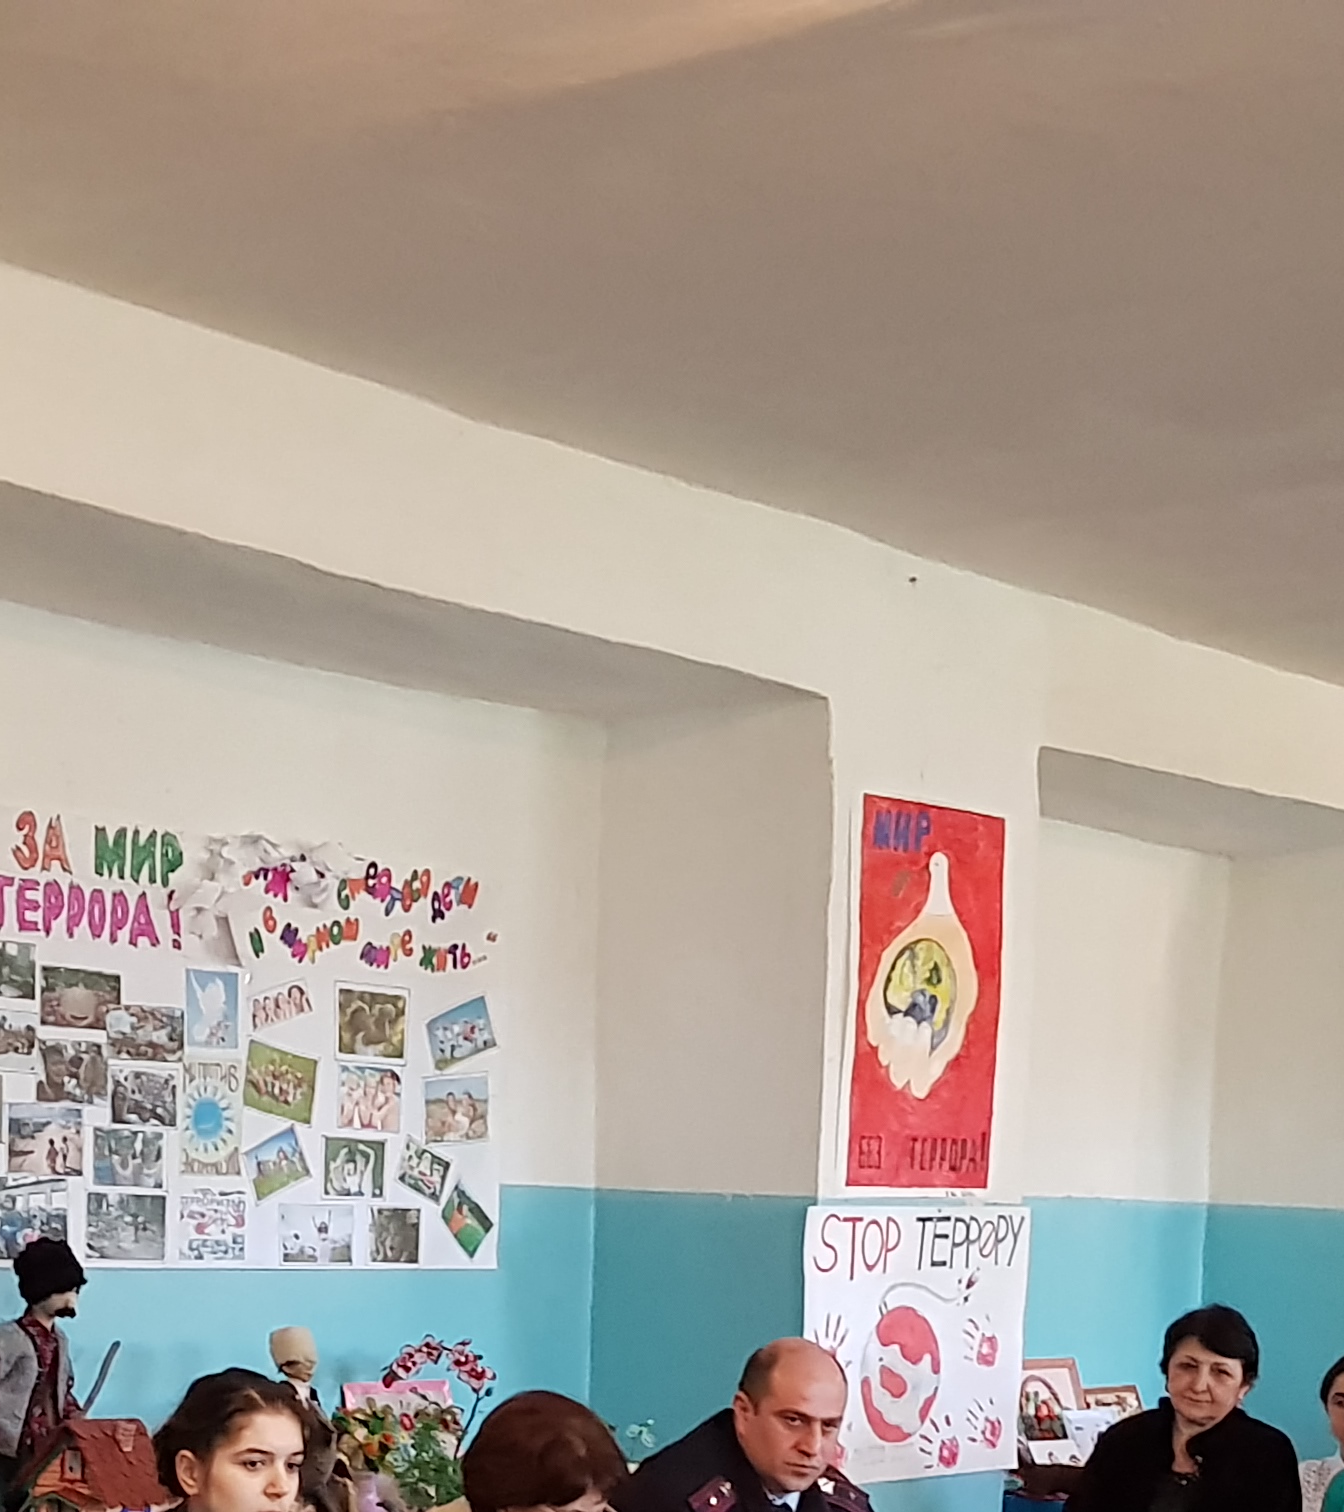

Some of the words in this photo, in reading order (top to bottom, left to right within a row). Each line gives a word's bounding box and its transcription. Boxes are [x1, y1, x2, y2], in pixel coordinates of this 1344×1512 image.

[11, 811, 73, 876] ЗА
[93, 824, 184, 888] МИР
[873, 810, 931, 853] МИР
[431, 876, 479, 924] дети
[359, 928, 414, 970] мире
[812, 1213, 902, 1282] STOP
[916, 1214, 1026, 1272] ТЕРРОРУ
